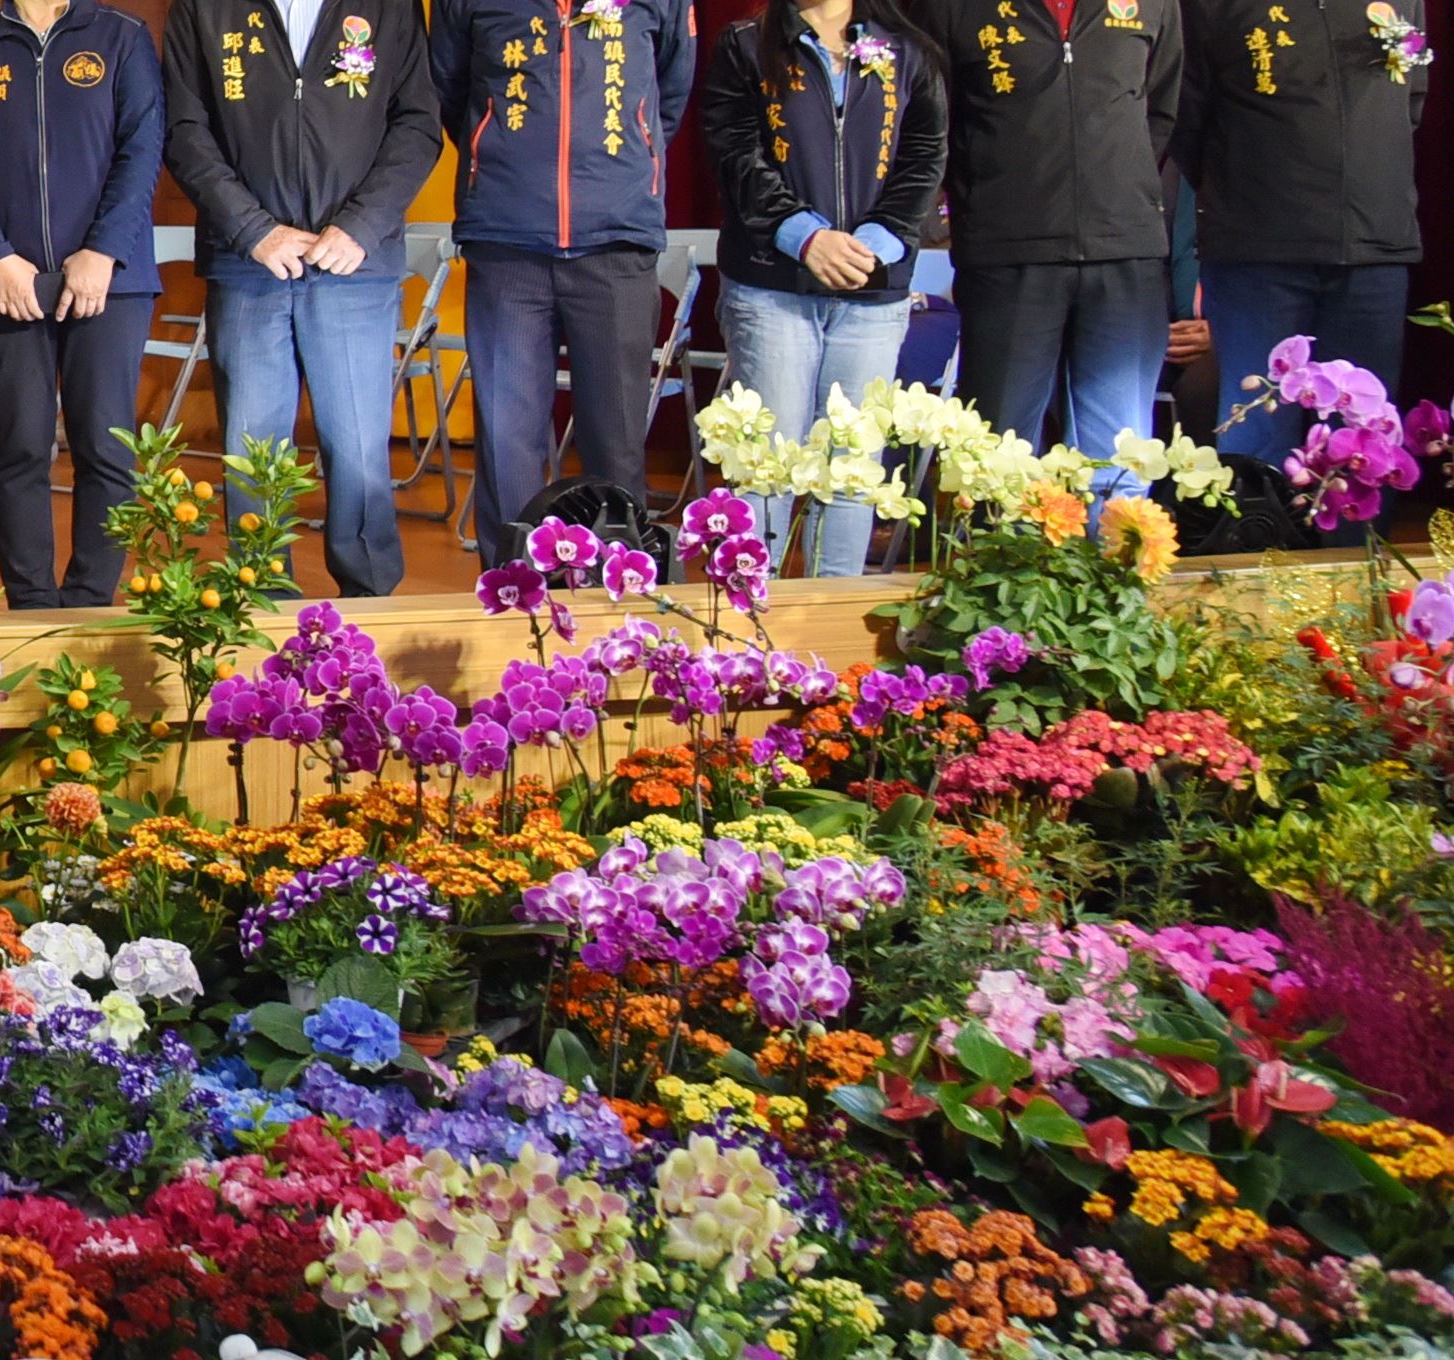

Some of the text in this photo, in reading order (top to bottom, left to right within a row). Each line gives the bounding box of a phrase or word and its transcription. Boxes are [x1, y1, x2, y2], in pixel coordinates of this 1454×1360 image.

[247, 12, 266, 55] 代表
[529, 16, 549, 56] 代表
[222, 32, 246, 101] 邱進旺
[502, 39, 529, 131] 林武宗
